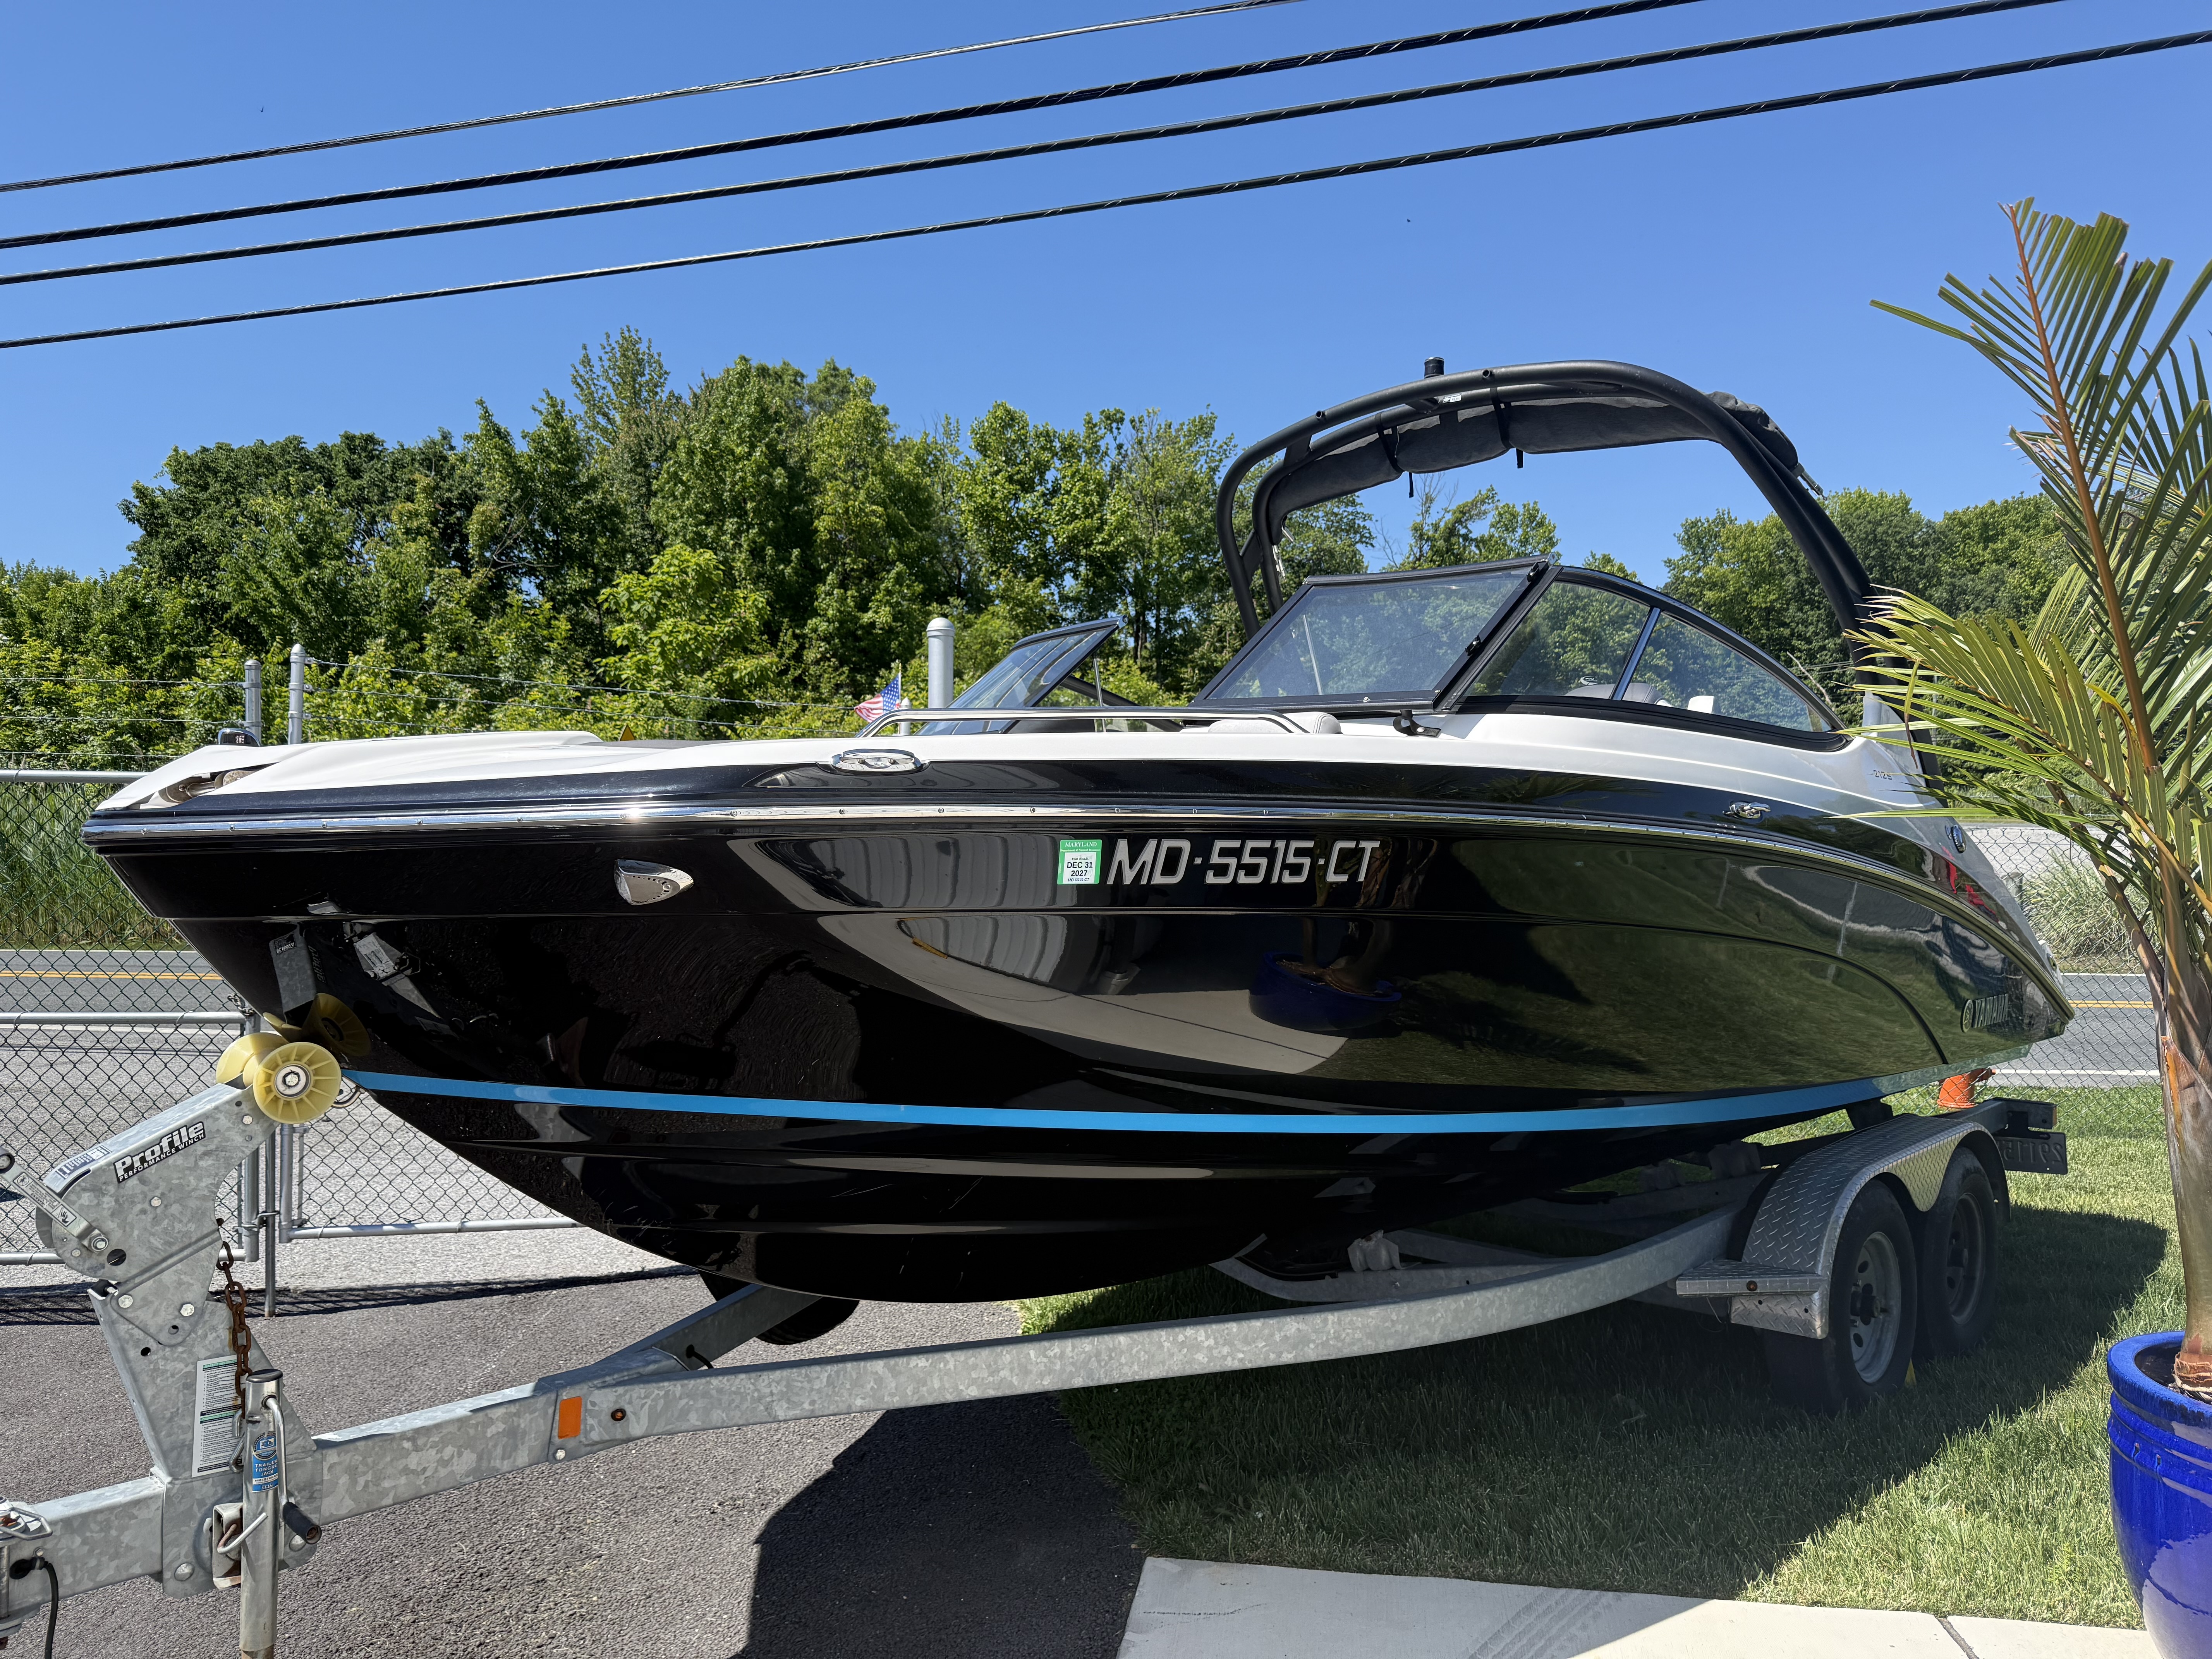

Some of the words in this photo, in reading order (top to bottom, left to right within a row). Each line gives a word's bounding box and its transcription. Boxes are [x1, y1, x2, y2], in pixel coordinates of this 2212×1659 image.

[1973, 994, 2009, 1028] YAMAHA
[115, 1122, 204, 1177] Profile
[119, 1148, 176, 1182] PERFORMANCE
[178, 1133, 204, 1150] WINCH
[255, 1459, 278, 1468] TRAILER
[255, 1463, 278, 1472] TONGUE
